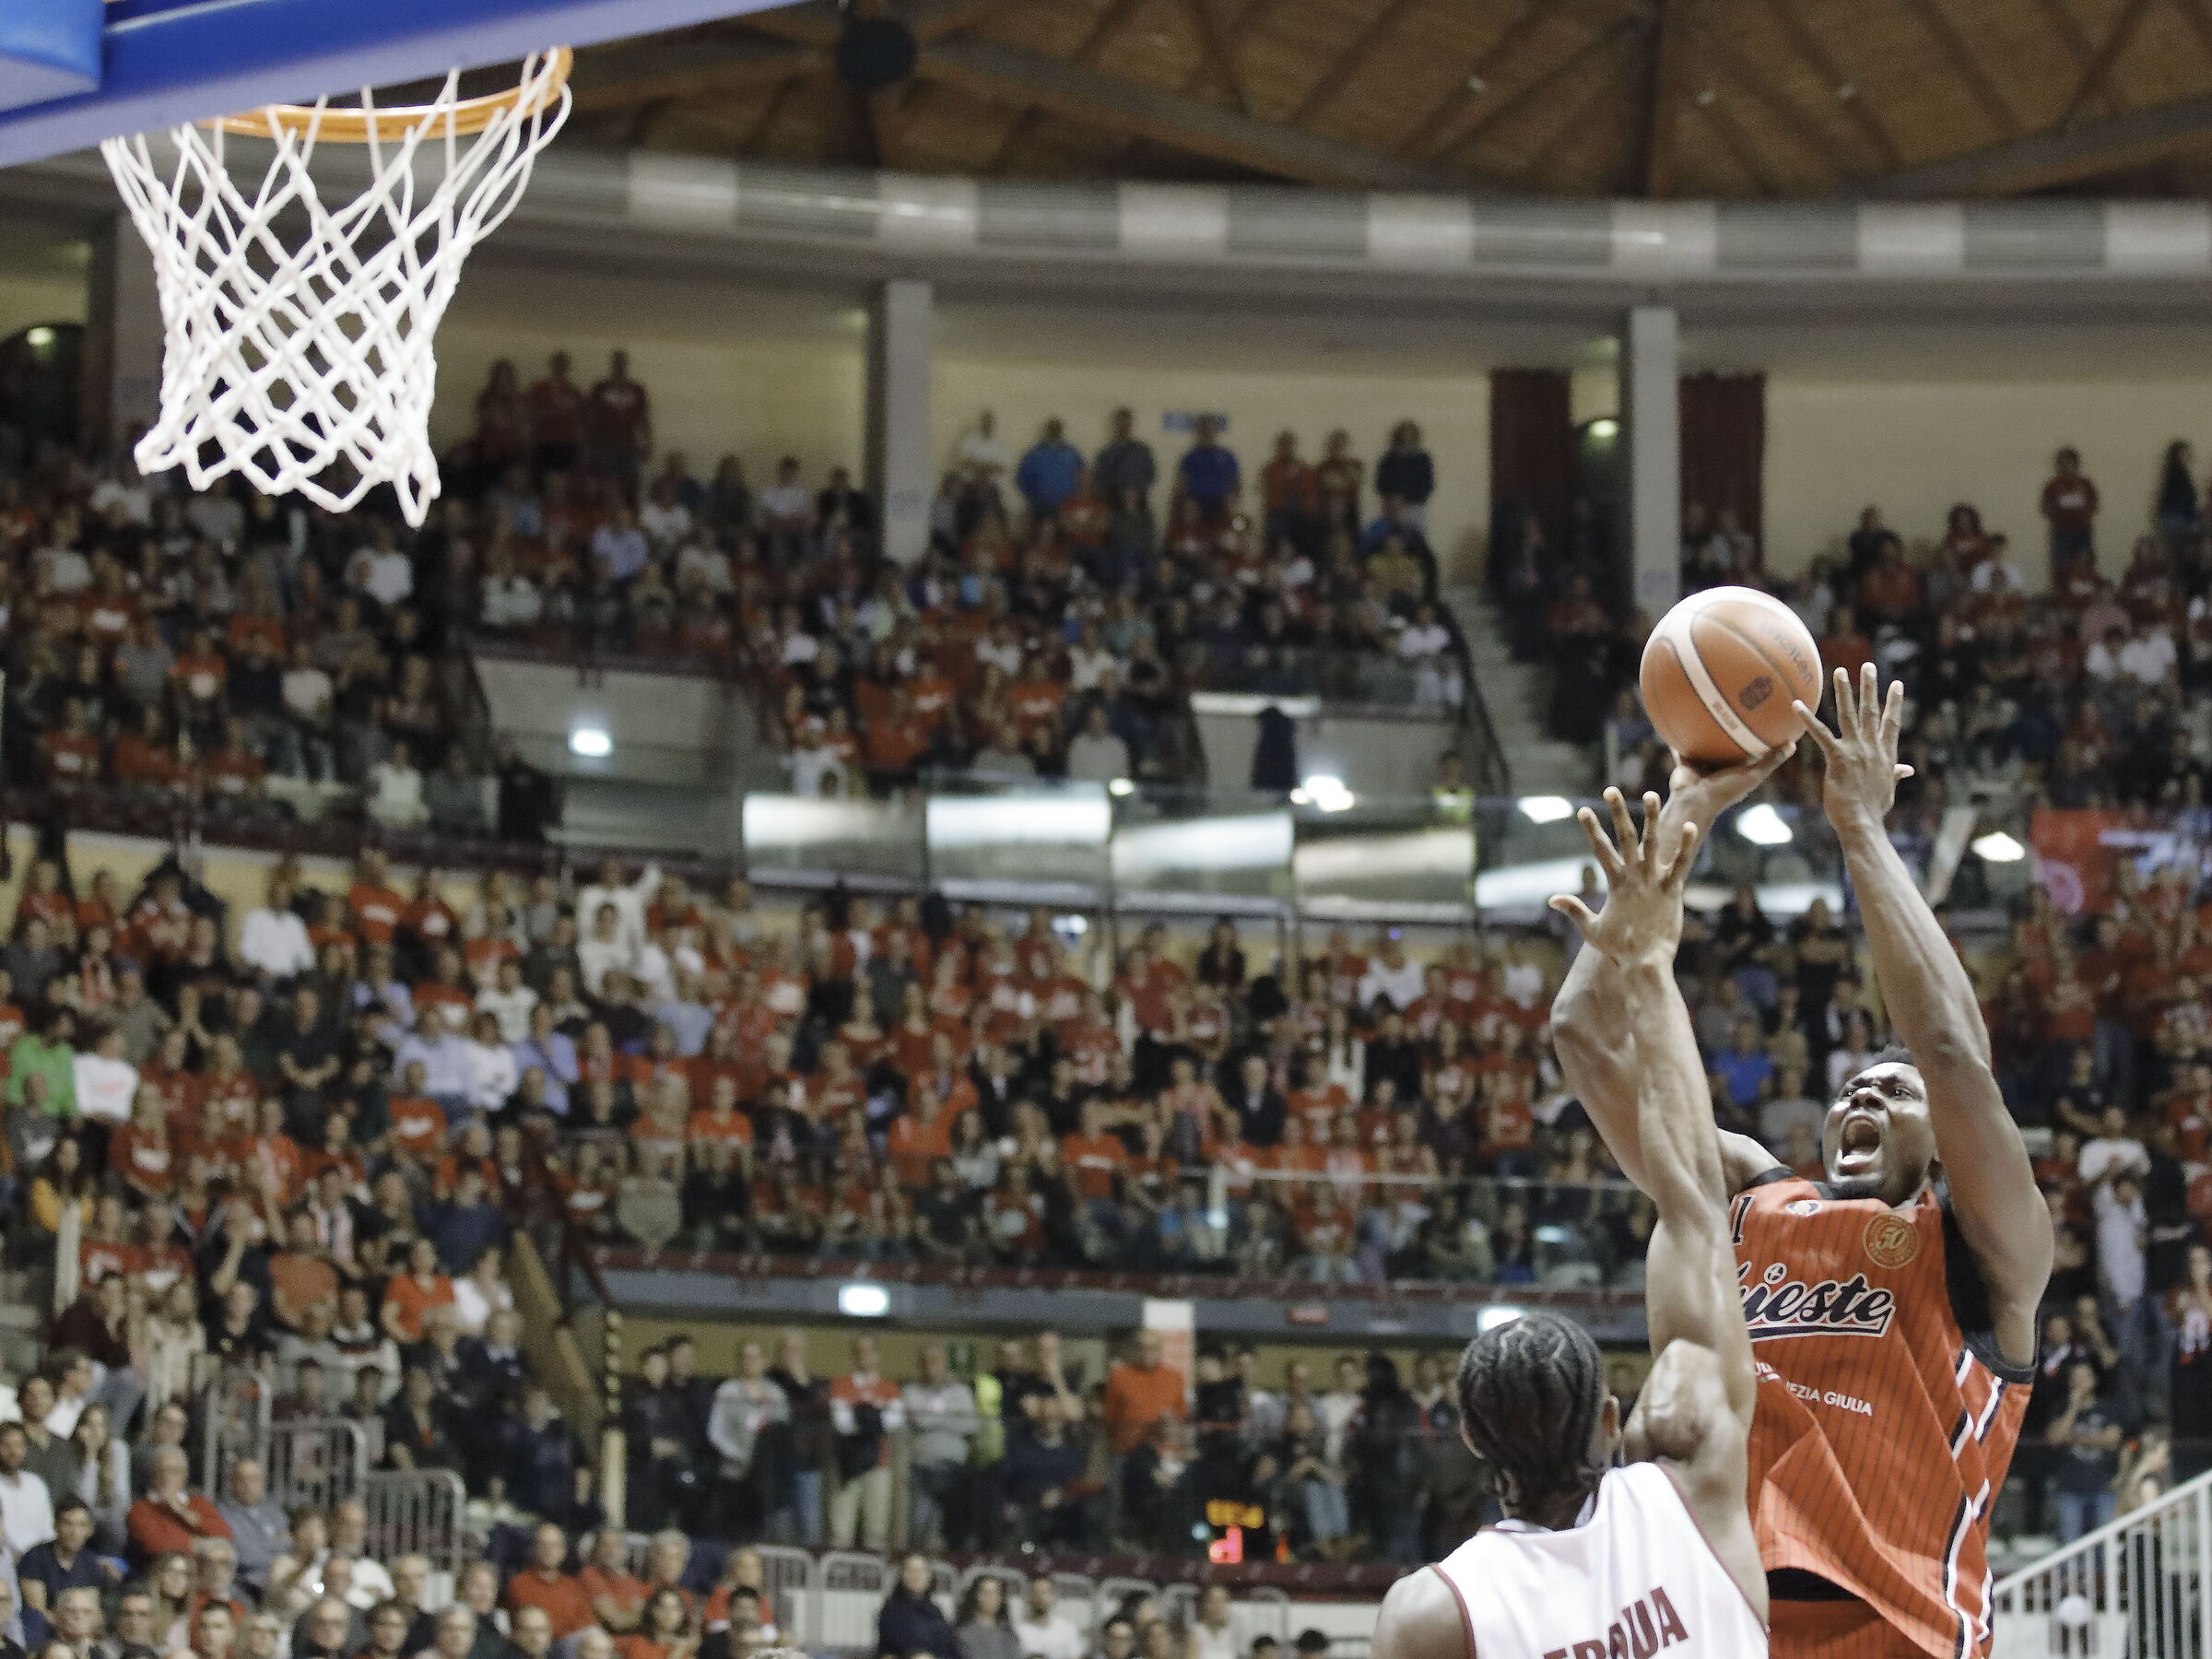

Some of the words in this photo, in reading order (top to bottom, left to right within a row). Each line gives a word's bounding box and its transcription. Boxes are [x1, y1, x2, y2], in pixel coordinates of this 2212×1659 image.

[1738, 1260, 1895, 1331] ieste
[1786, 1381, 1820, 1402] EZIA
[1823, 1390, 1873, 1417] GIULIA
